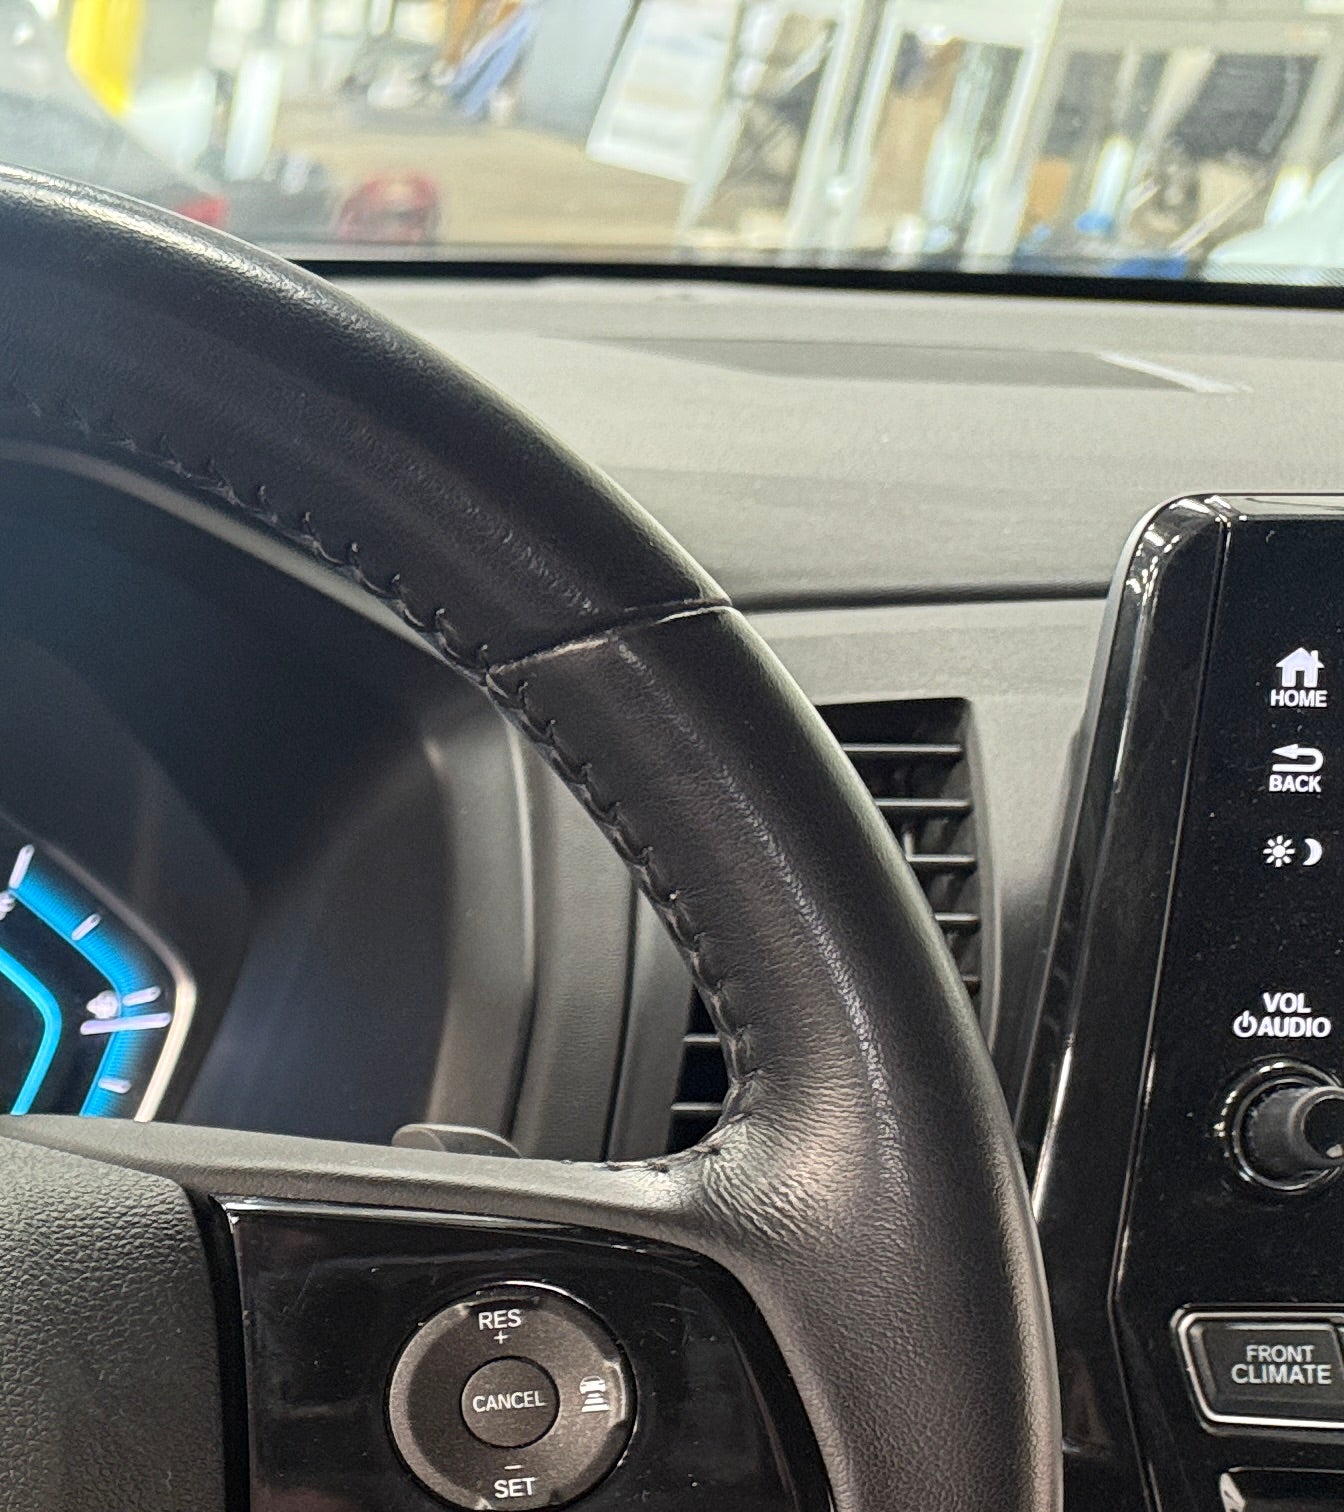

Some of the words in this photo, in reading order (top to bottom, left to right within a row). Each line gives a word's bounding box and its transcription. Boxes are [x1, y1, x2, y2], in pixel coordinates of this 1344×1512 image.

[1269, 688, 1328, 708] HOME
[1268, 774, 1322, 793] BACK
[1263, 992, 1312, 1014] VOL
[1257, 1016, 1332, 1039] AUDIO
[477, 1309, 523, 1332] RES
[1245, 1344, 1315, 1364] FRONT
[1230, 1363, 1333, 1386] CLIMATE
[471, 1390, 547, 1413] CANCEL
[493, 1476, 537, 1500] SET
